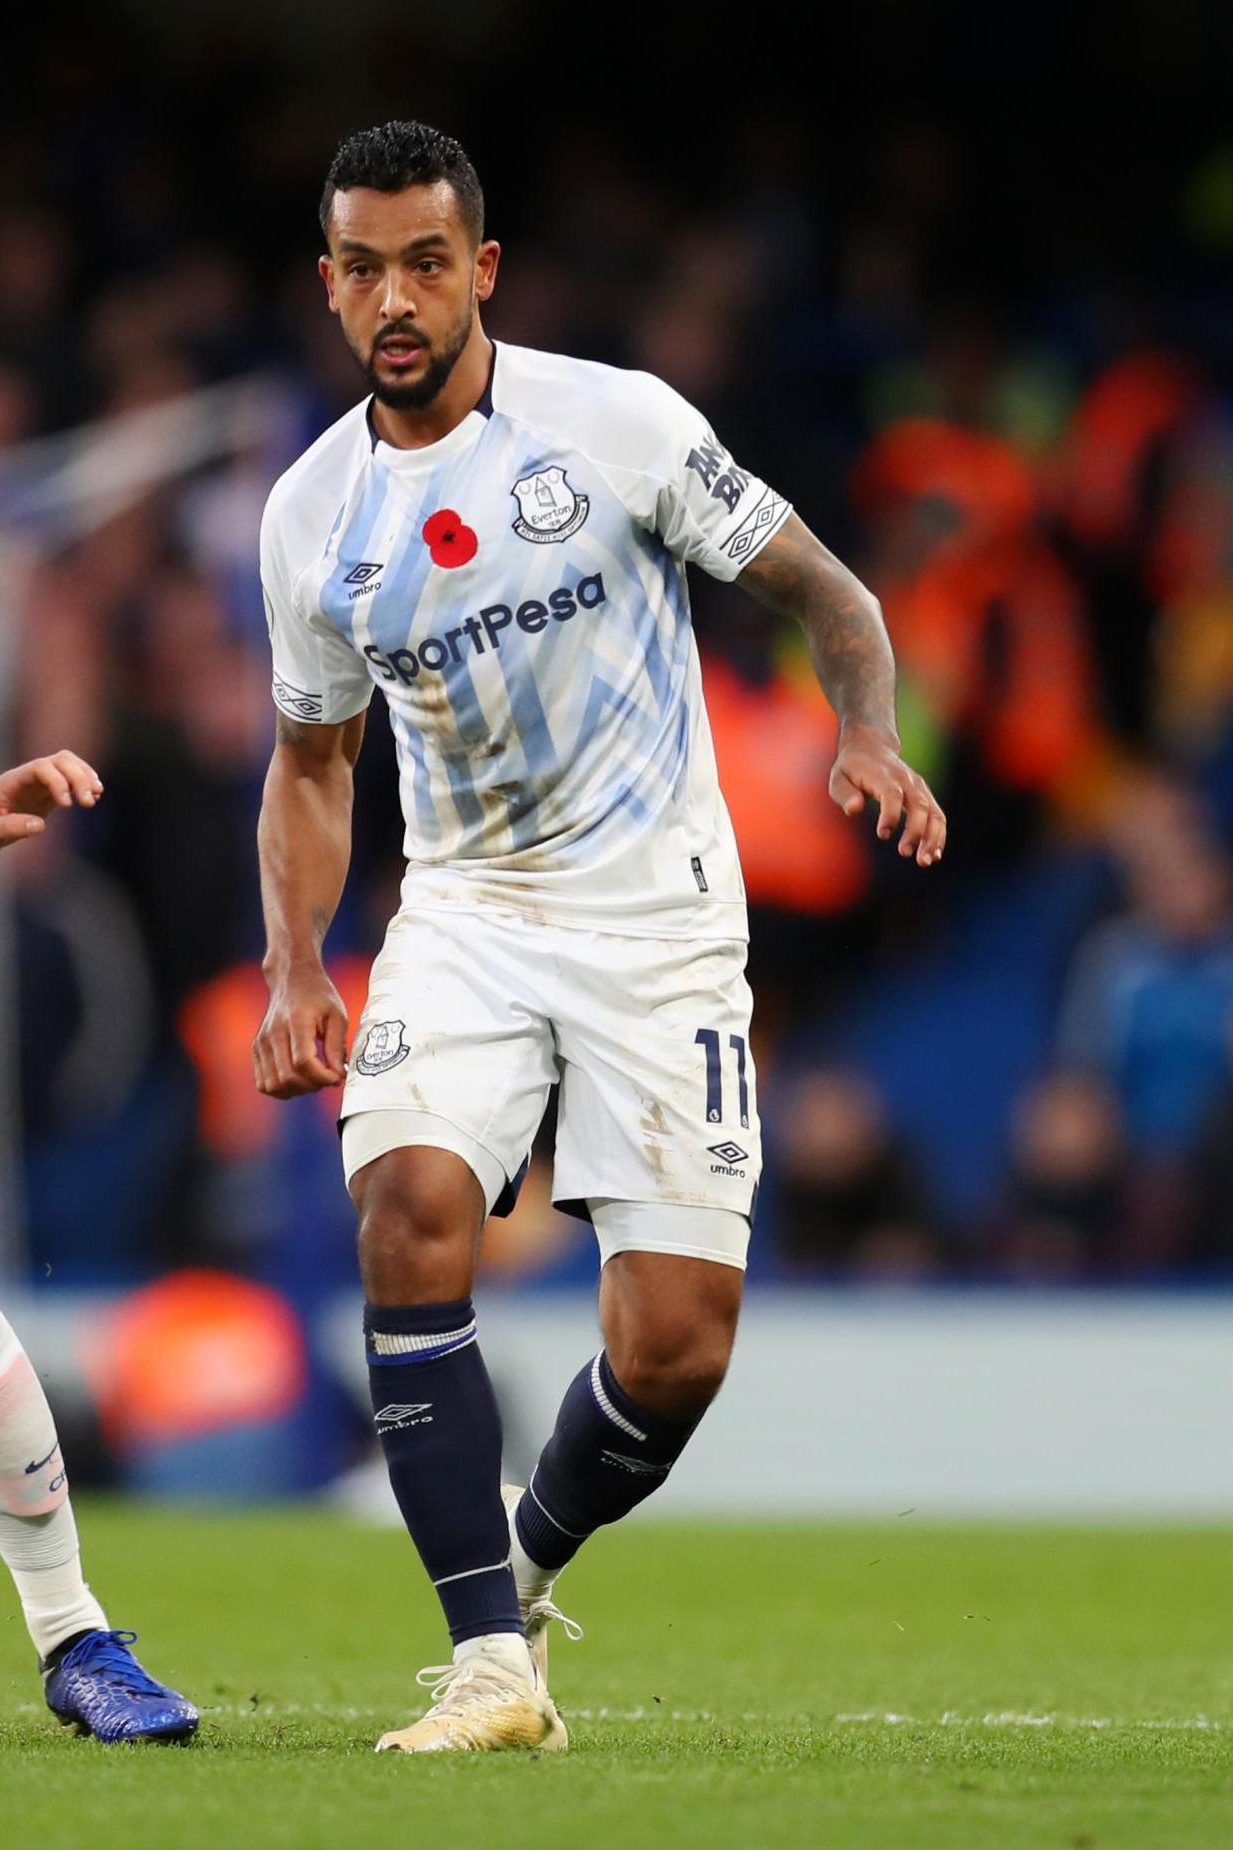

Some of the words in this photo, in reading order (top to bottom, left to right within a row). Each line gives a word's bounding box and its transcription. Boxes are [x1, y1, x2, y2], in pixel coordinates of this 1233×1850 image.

[531, 505, 572, 525] Everton
[348, 582, 382, 600] umbro
[363, 572, 607, 686] SportPesa
[694, 1028, 750, 1130] 11
[710, 1164, 746, 1179] umbro
[376, 1416, 434, 1436] umbro
